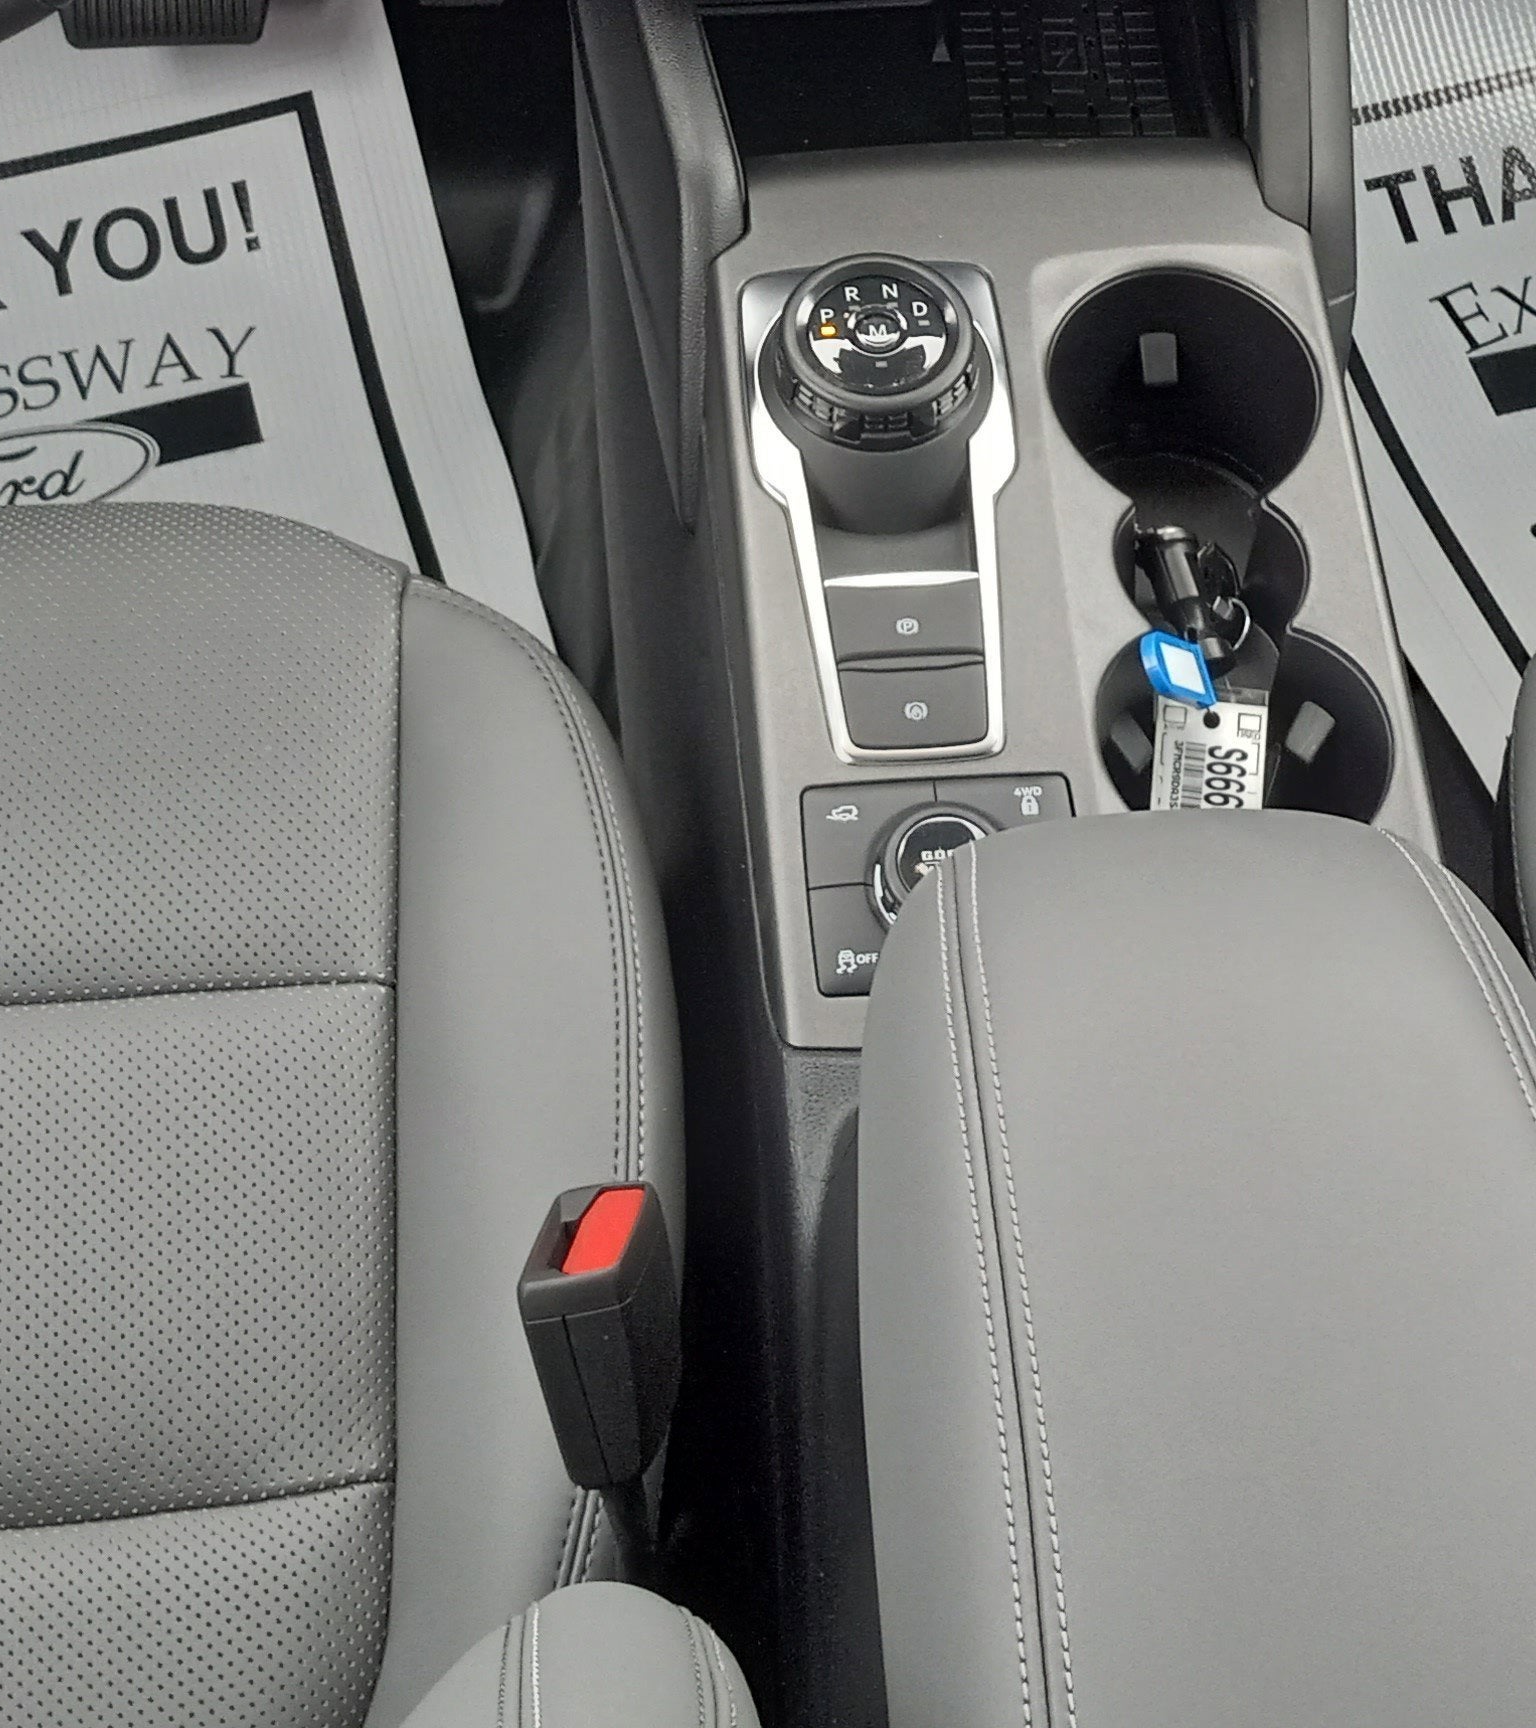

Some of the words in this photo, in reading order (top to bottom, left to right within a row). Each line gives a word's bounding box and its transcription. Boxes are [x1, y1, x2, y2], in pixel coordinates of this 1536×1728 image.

[20, 178, 266, 300] YOU!
[820, 308, 835, 323] P
[844, 286, 861, 302] R
[881, 283, 898, 299] N
[912, 301, 928, 316] D
[1013, 786, 1043, 798] 4WD
[856, 953, 879, 964] OFF
